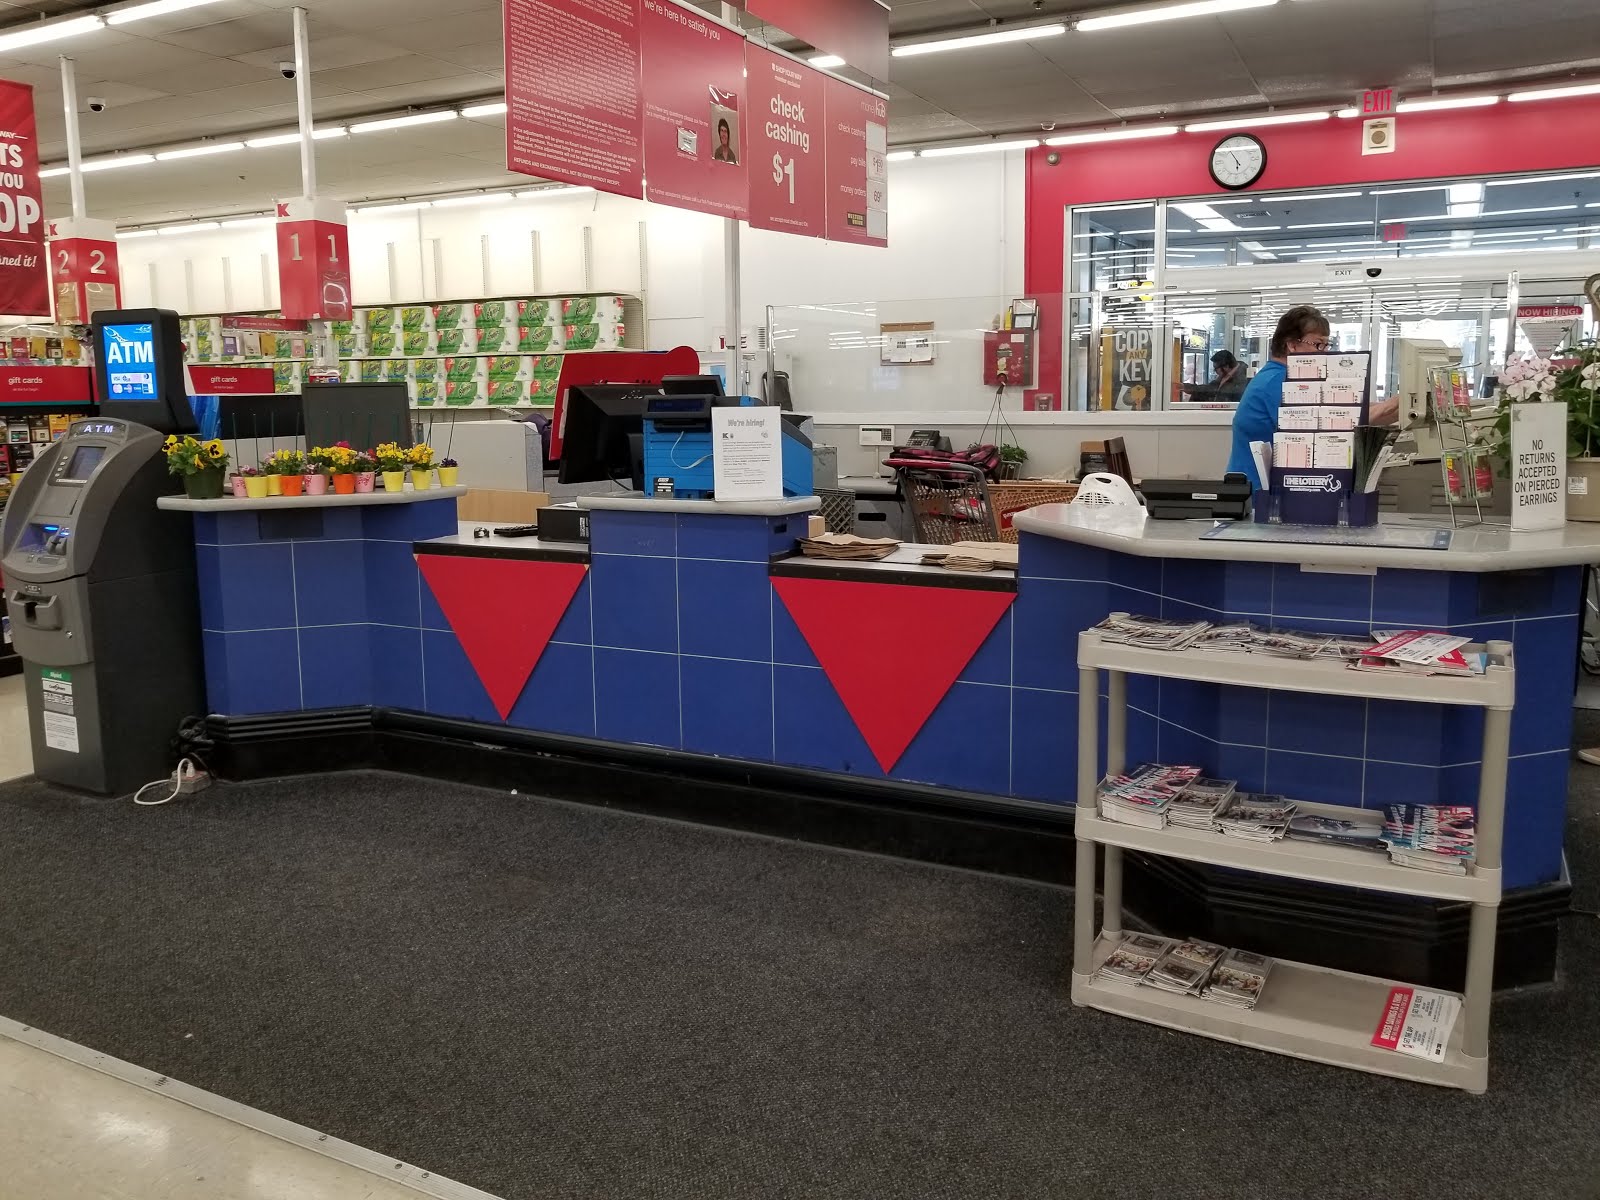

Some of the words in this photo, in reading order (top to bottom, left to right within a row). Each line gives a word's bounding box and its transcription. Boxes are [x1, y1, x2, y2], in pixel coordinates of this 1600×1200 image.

[664, 6, 678, 21] here
[680, 14, 686, 25] to
[688, 20, 708, 36] satisfy
[709, 29, 720, 40] you
[1363, 89, 1393, 112] EXIT
[771, 94, 805, 123] check
[766, 121, 810, 153] cashing
[772, 151, 795, 204] $1
[277, 202, 290, 217] K
[290, 232, 303, 260] 1
[328, 234, 338, 262] 1
[24, 255, 37, 267] it!
[58, 250, 69, 274] 2
[90, 250, 106, 274] 2
[108, 341, 153, 364] ATM
[1128, 351, 1145, 359] ANY
[1120, 359, 1152, 382] KEY
[8, 377, 21, 385] gift
[84, 425, 113, 433] ATM
[746, 419, 765, 427] hiring!
[1532, 440, 1543, 450] NO
[1520, 452, 1555, 465] RETURNS
[1518, 465, 1557, 479] ACCEPTED
[1286, 477, 1300, 485] THE
[1300, 476, 1329, 486] LOTTERY
[1515, 482, 1526, 493] ON
[1528, 479, 1560, 492] PIERCED
[1520, 492, 1558, 506] EARRINGS
